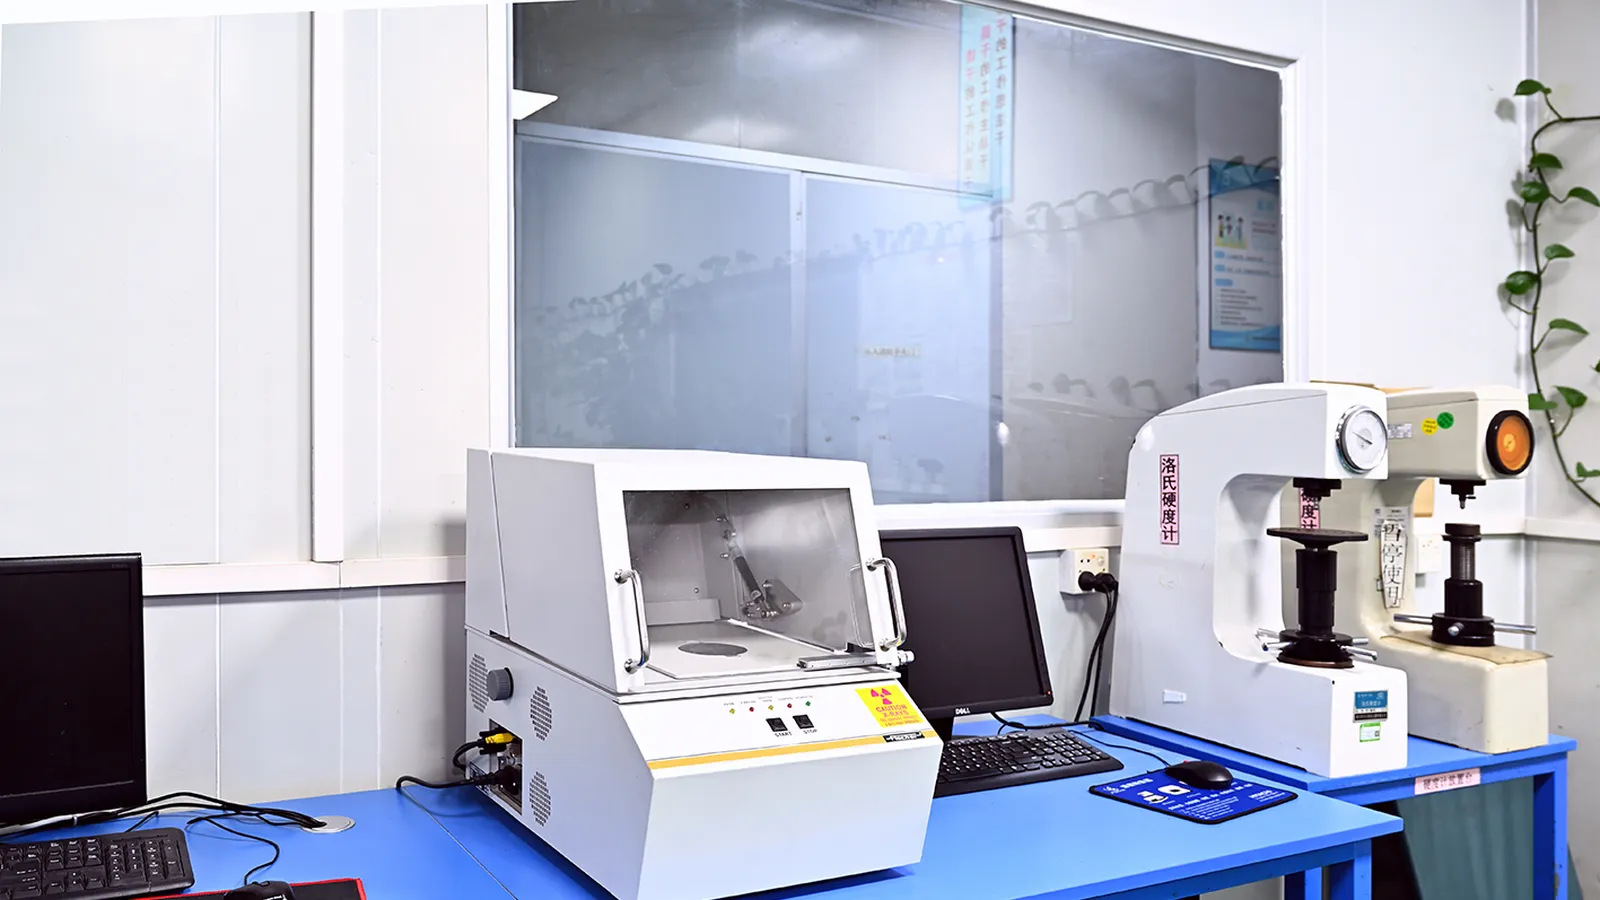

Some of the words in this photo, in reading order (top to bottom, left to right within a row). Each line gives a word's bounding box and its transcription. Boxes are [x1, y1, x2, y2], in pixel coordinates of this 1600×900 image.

[1161, 457, 1177, 541] 洛氏硬度计
[876, 704, 907, 712] CAUTION
[955, 707, 971, 715] DELL
